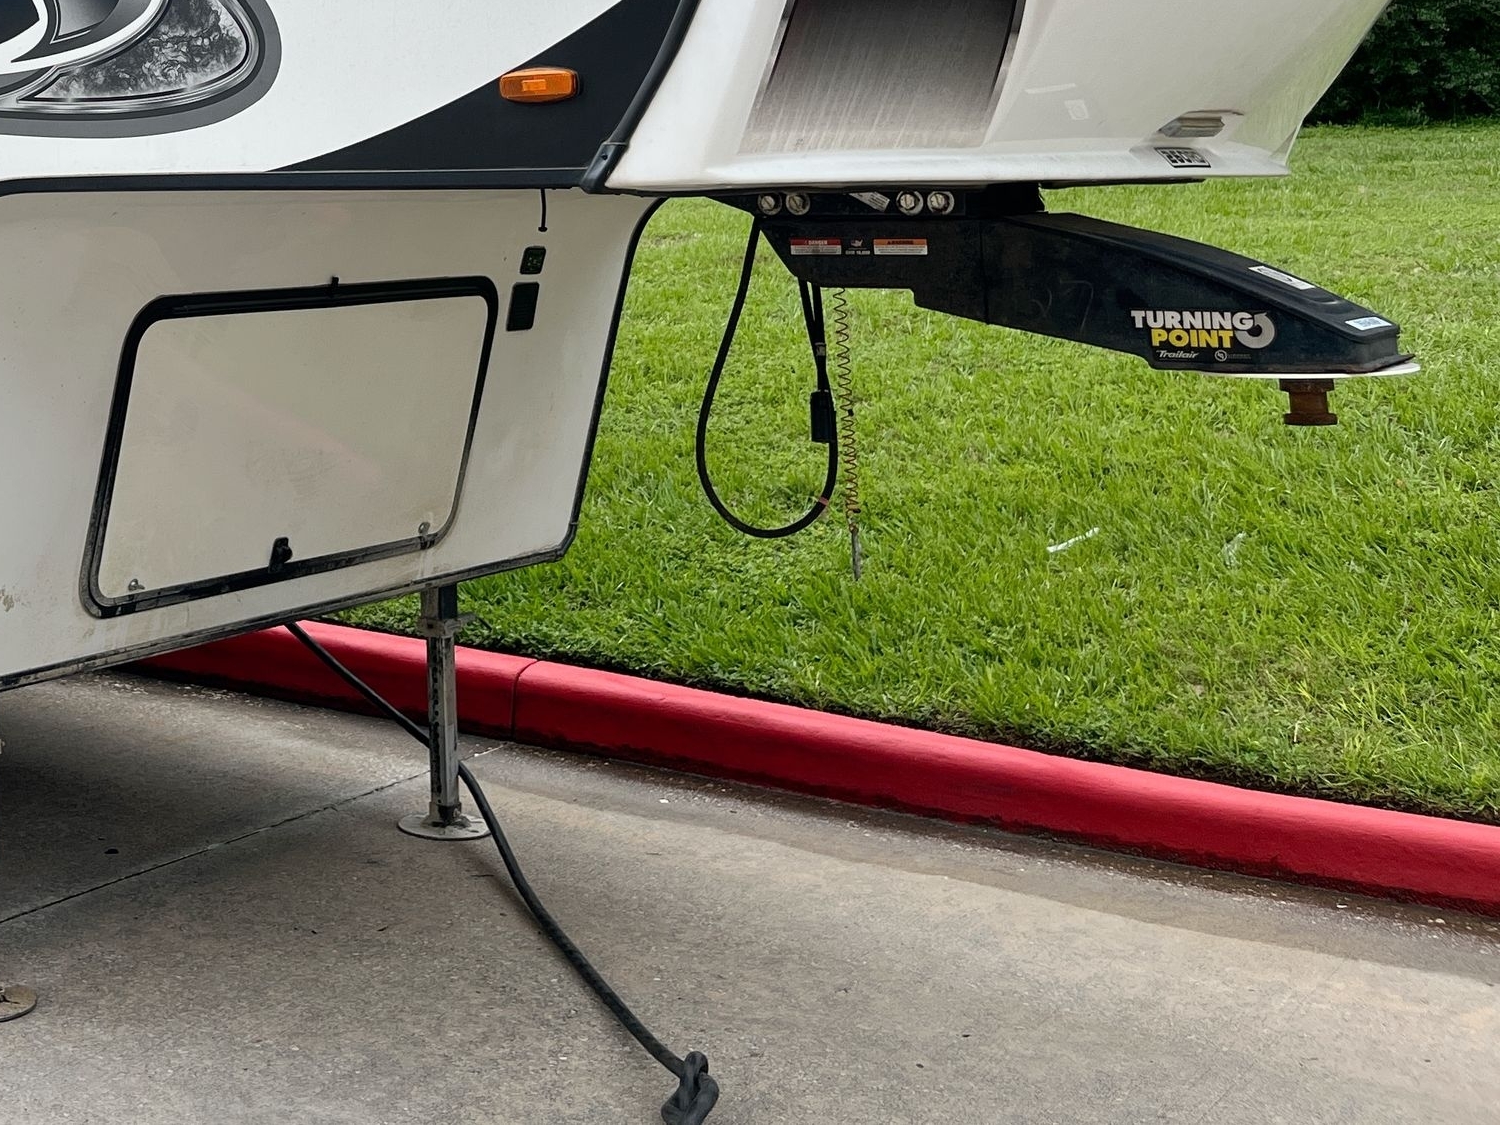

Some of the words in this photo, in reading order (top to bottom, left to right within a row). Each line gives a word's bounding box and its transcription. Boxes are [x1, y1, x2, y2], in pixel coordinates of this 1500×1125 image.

[1130, 310, 1254, 331] TURNING
[1151, 329, 1234, 348] POINT
[1156, 349, 1199, 359] Trailair
